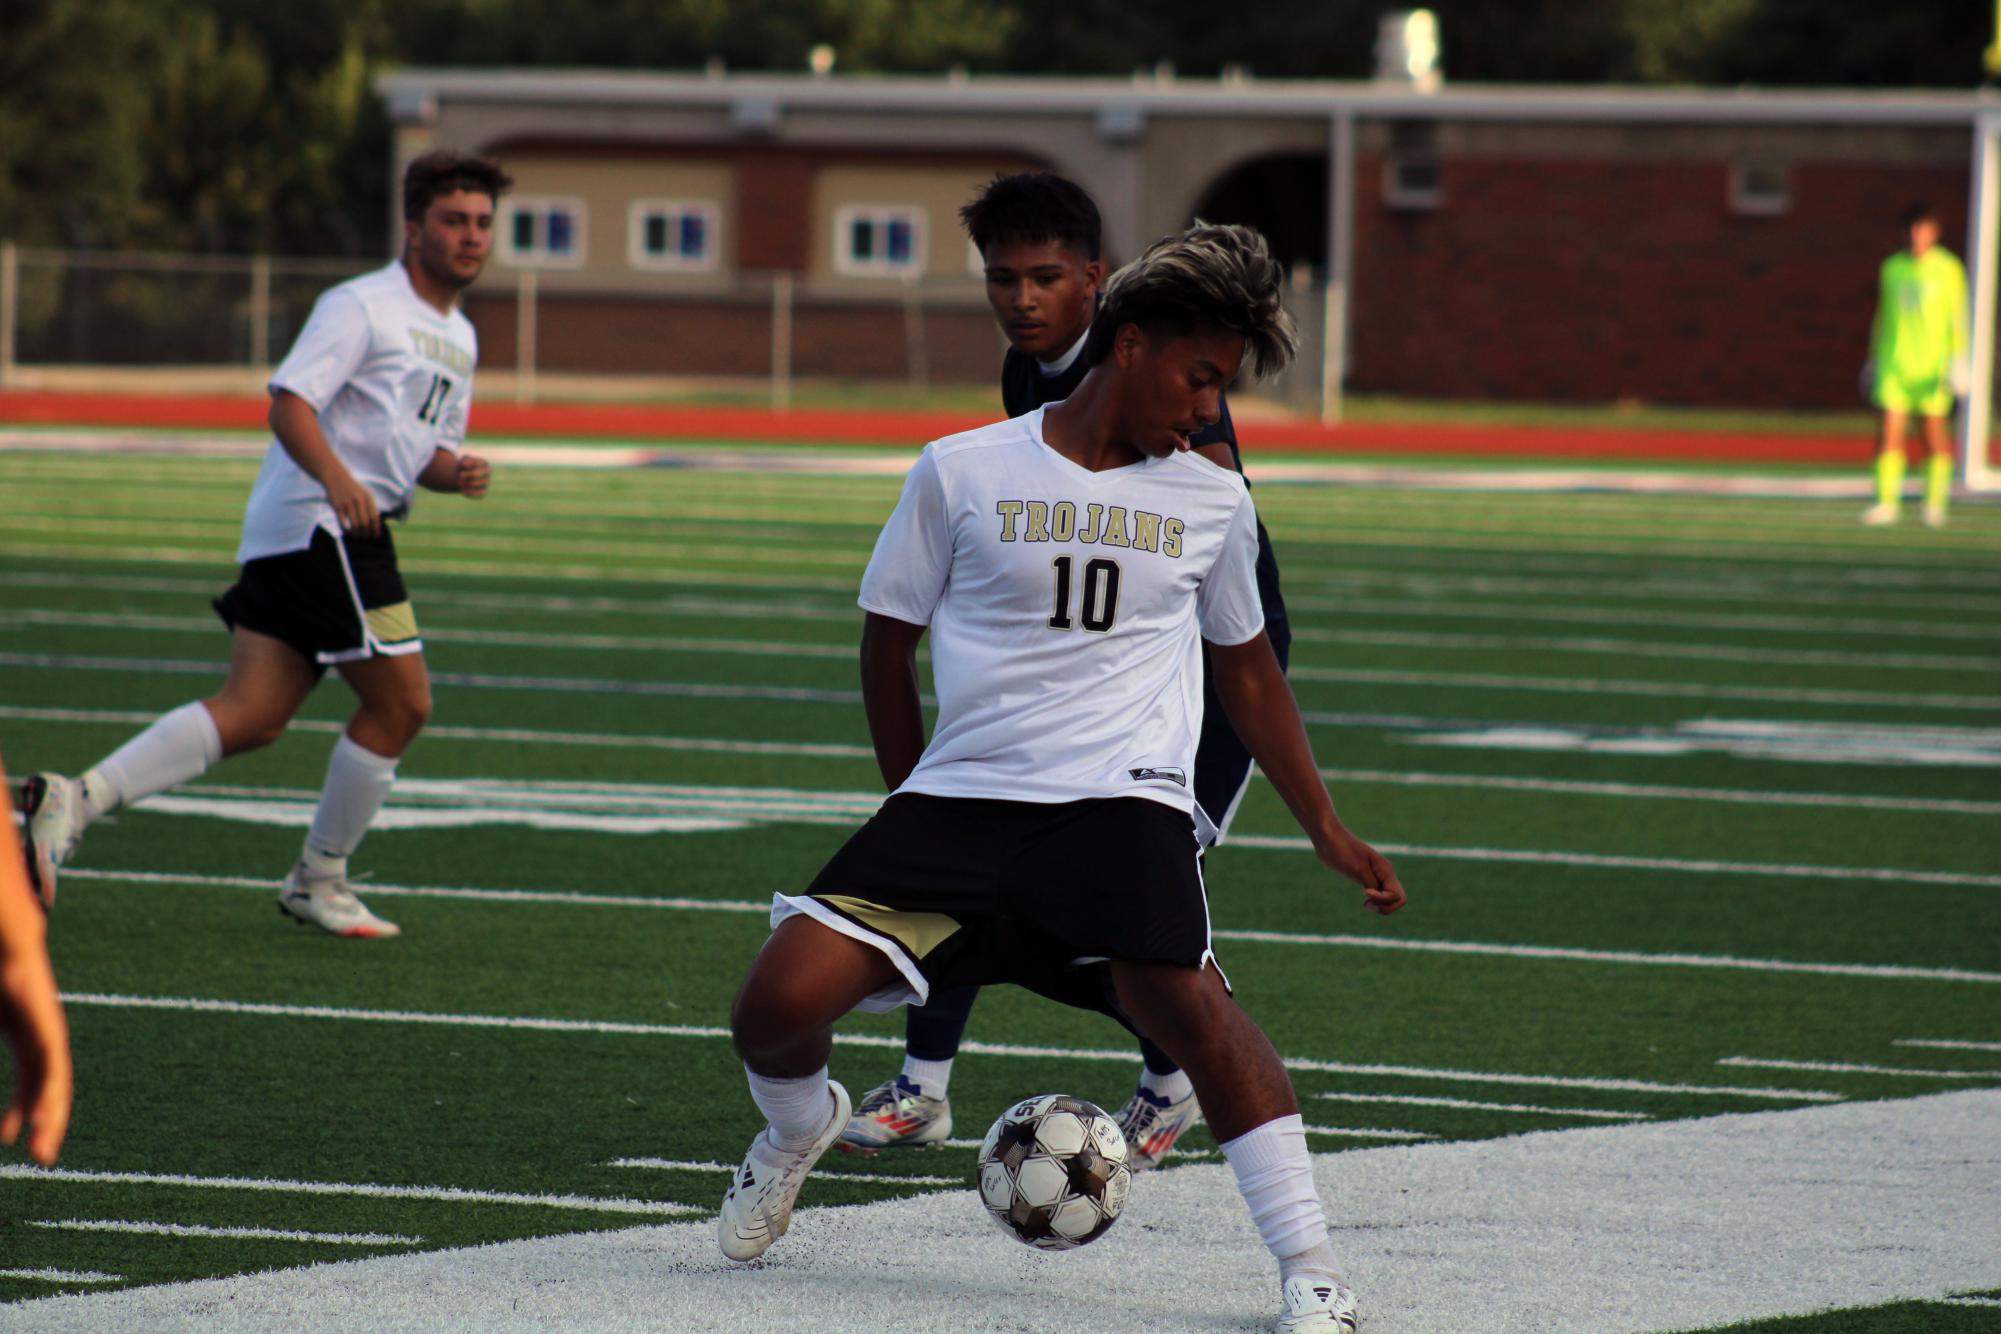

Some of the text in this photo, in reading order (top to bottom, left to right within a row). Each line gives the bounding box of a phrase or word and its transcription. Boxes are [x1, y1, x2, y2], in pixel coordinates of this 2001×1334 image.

[418, 373, 452, 426] 17
[997, 500, 1185, 558] TROJANS
[1047, 553, 1123, 635] 10
